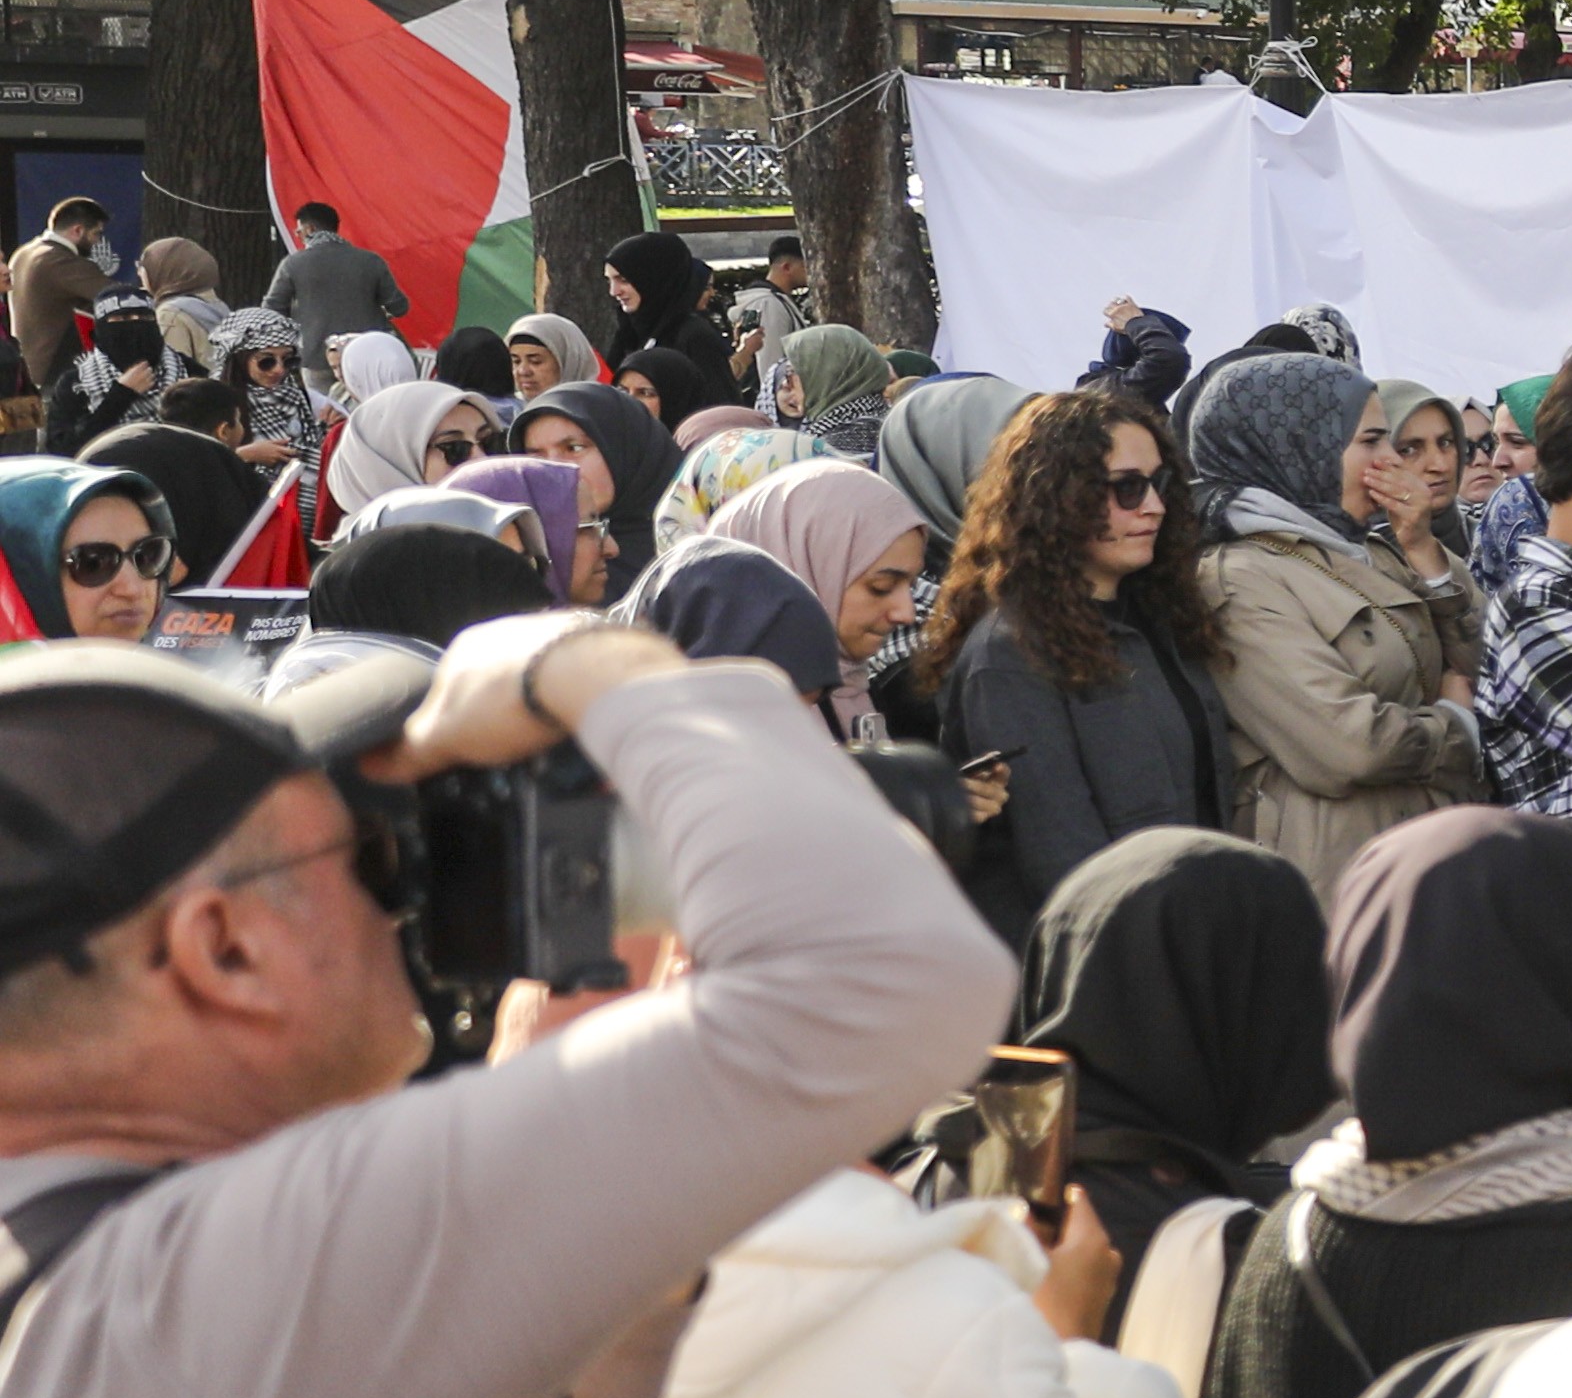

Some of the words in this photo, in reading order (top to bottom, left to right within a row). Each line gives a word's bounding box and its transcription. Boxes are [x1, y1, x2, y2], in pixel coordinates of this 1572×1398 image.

[161, 611, 235, 635] GAZA
[244, 626, 299, 642] NOMBRES
[154, 637, 179, 649] DES
